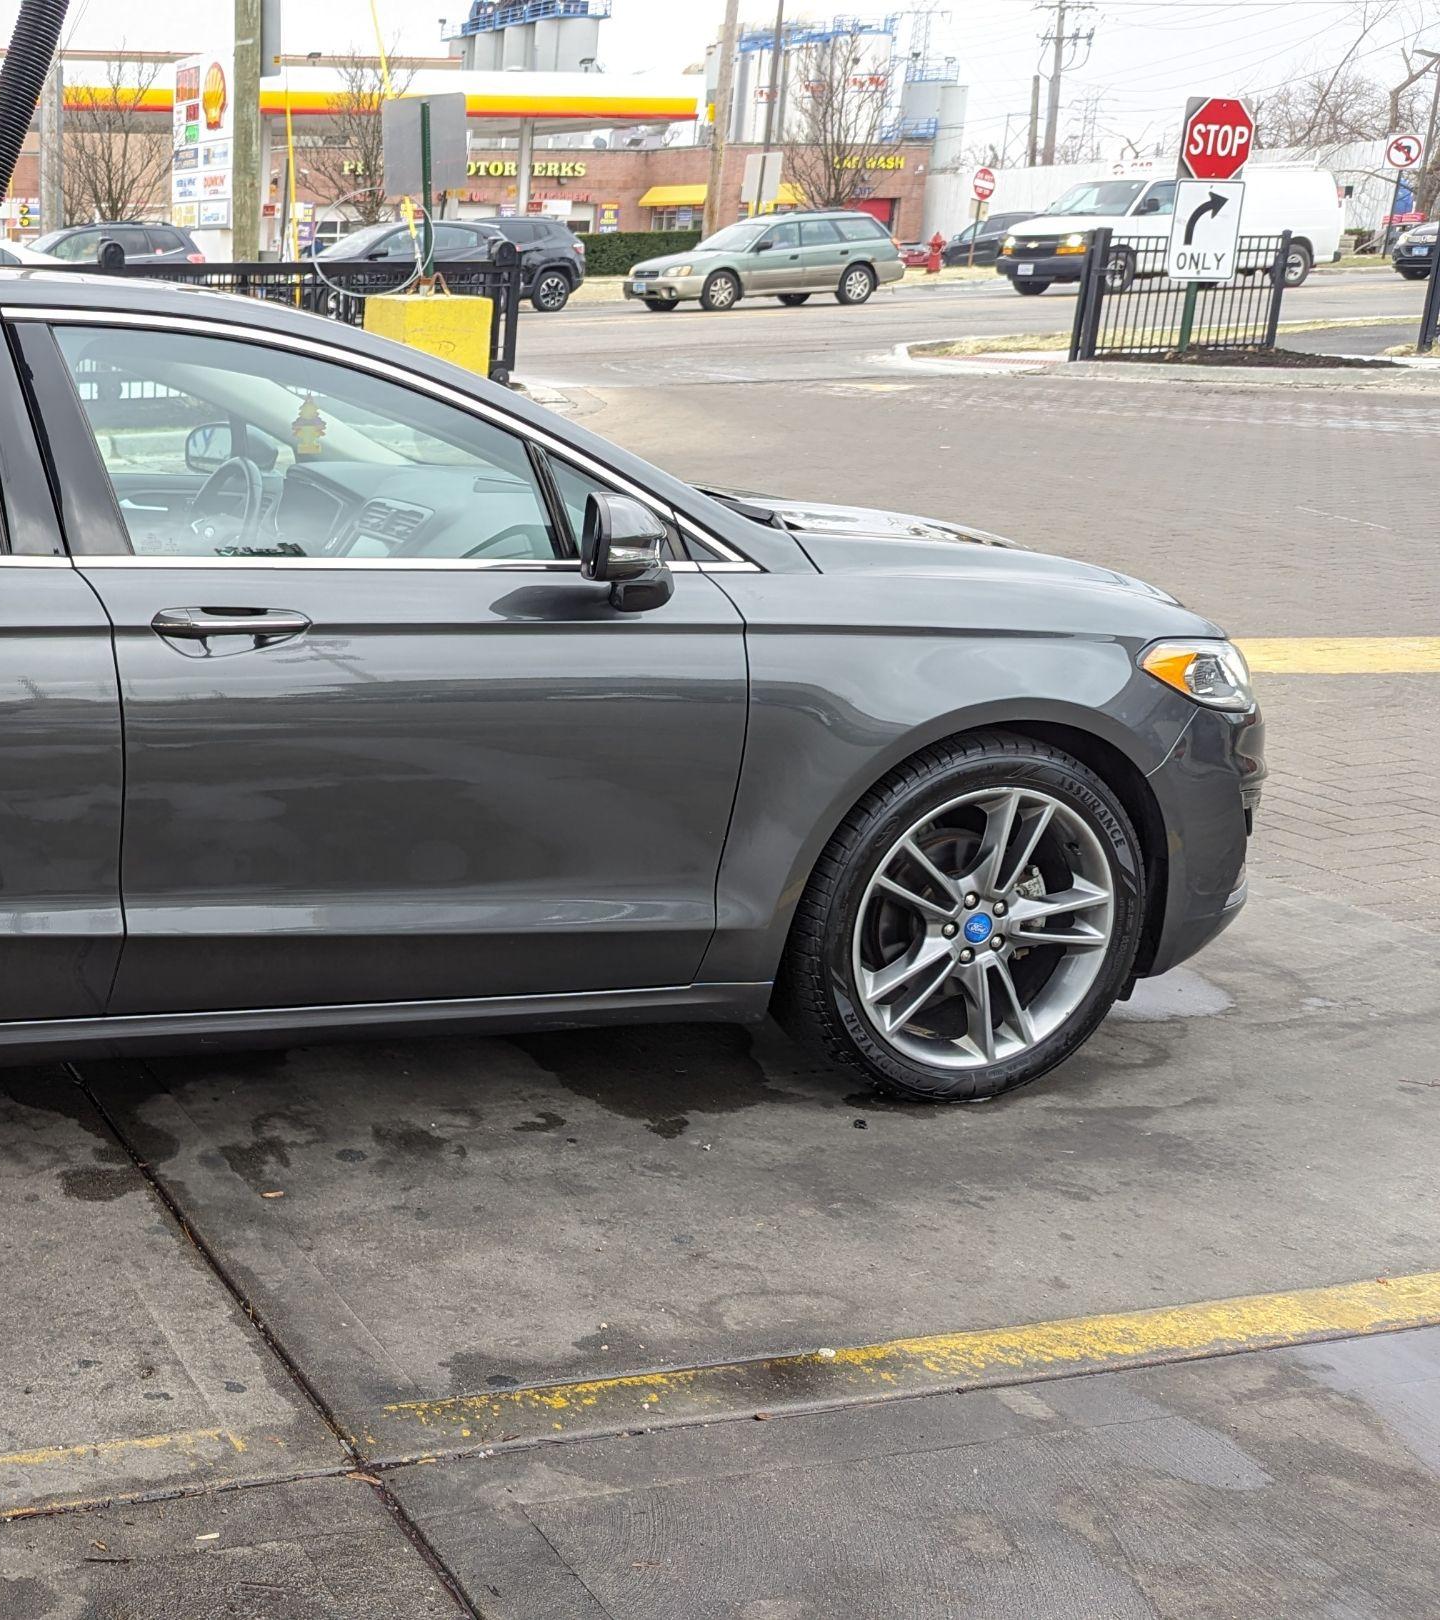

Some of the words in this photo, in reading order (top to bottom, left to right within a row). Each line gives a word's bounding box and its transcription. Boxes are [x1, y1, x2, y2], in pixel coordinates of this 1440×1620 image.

[1189, 123, 1249, 157] STOP
[467, 160, 517, 177] OTOR
[532, 162, 587, 177] ERKS
[865, 156, 905, 169] WASH
[1176, 252, 1226, 271] ONLY
[1057, 776, 1126, 848] ASSURANCE
